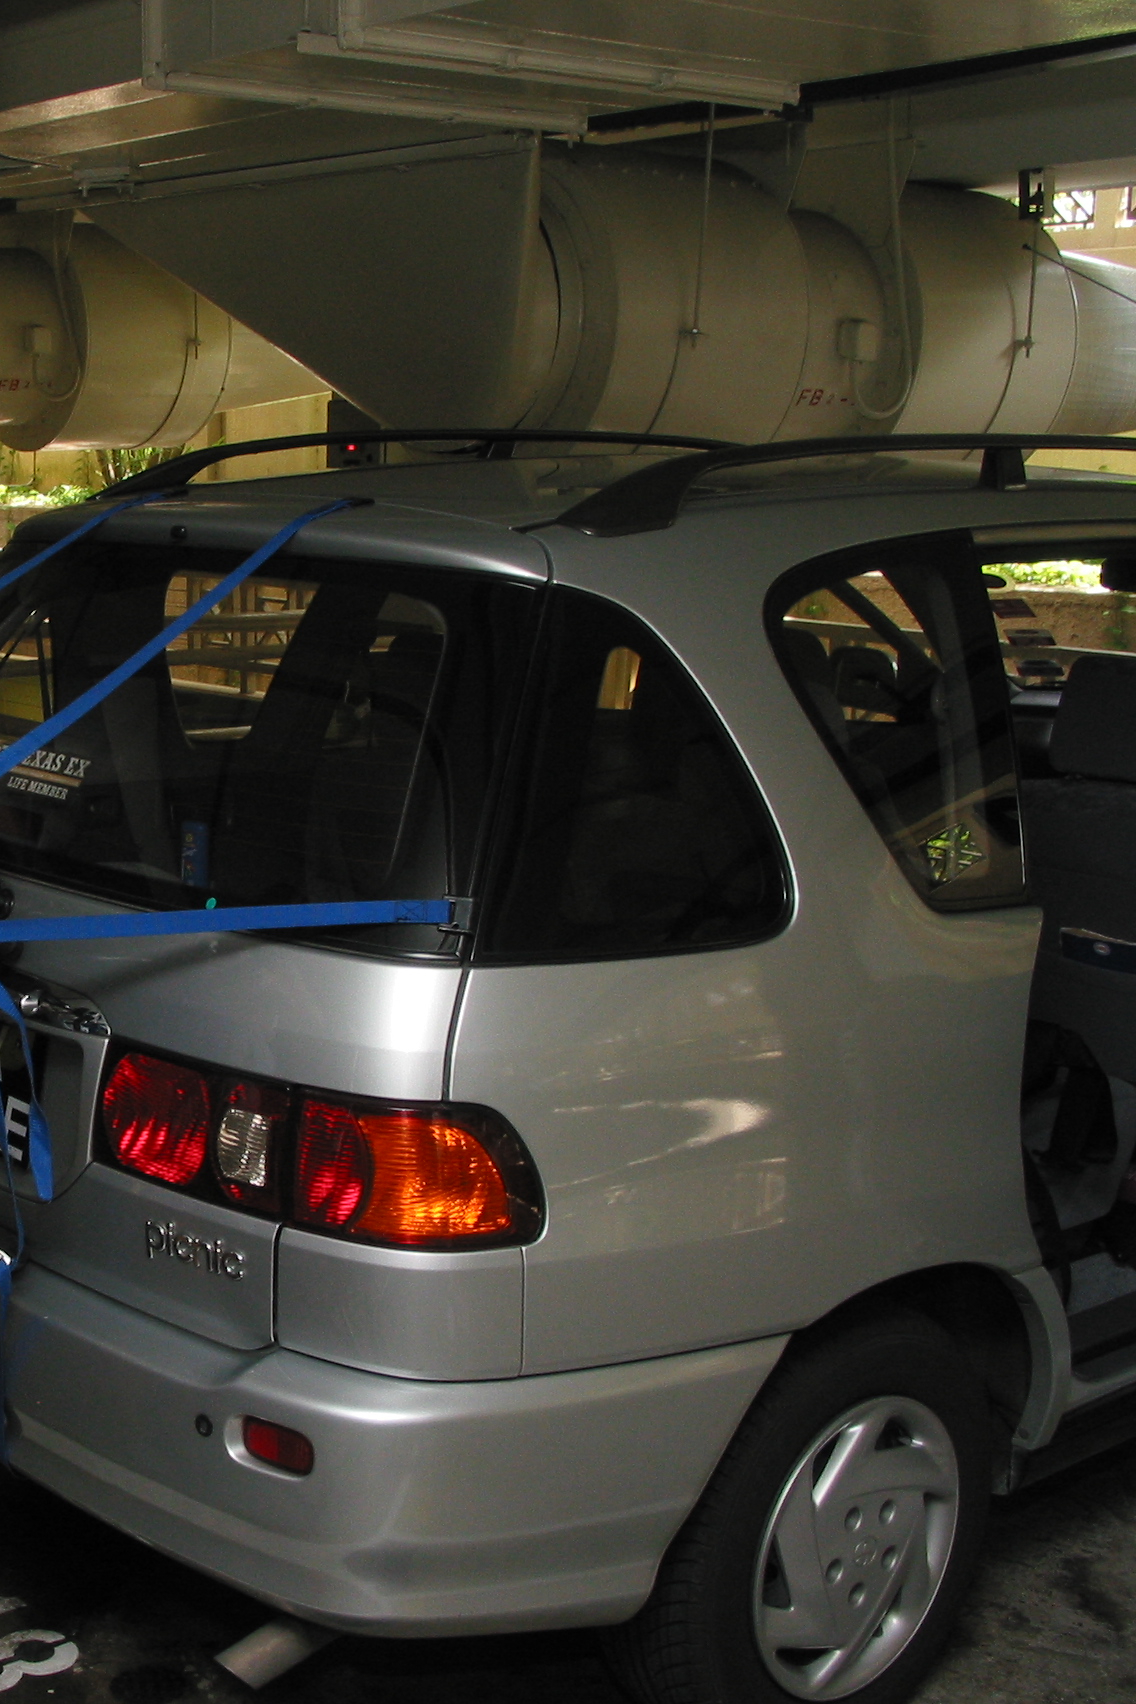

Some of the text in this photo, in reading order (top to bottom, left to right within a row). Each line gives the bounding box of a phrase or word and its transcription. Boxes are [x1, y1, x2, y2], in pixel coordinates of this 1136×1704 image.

[21, 749, 92, 779] EXAS EX
[6, 775, 69, 800] LIFE MEMBER
[145, 1218, 246, 1281] picnic
